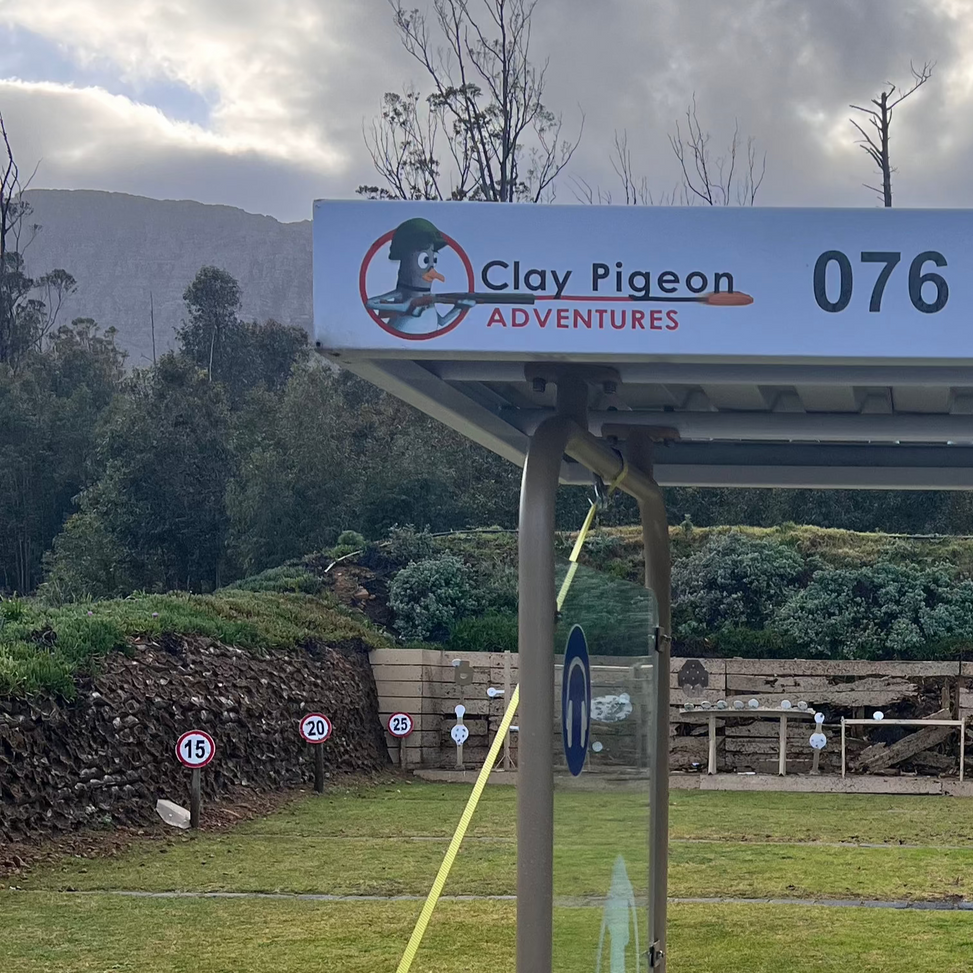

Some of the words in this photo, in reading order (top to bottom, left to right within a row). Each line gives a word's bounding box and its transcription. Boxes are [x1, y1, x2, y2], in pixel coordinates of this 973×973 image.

[481, 260, 573, 299] Clay
[592, 262, 734, 298] Pigeon
[812, 250, 950, 314] 076
[486, 308, 680, 331] ADVENTURES
[306, 719, 325, 737] 20
[393, 717, 408, 731] 25
[183, 739, 206, 760] 15
